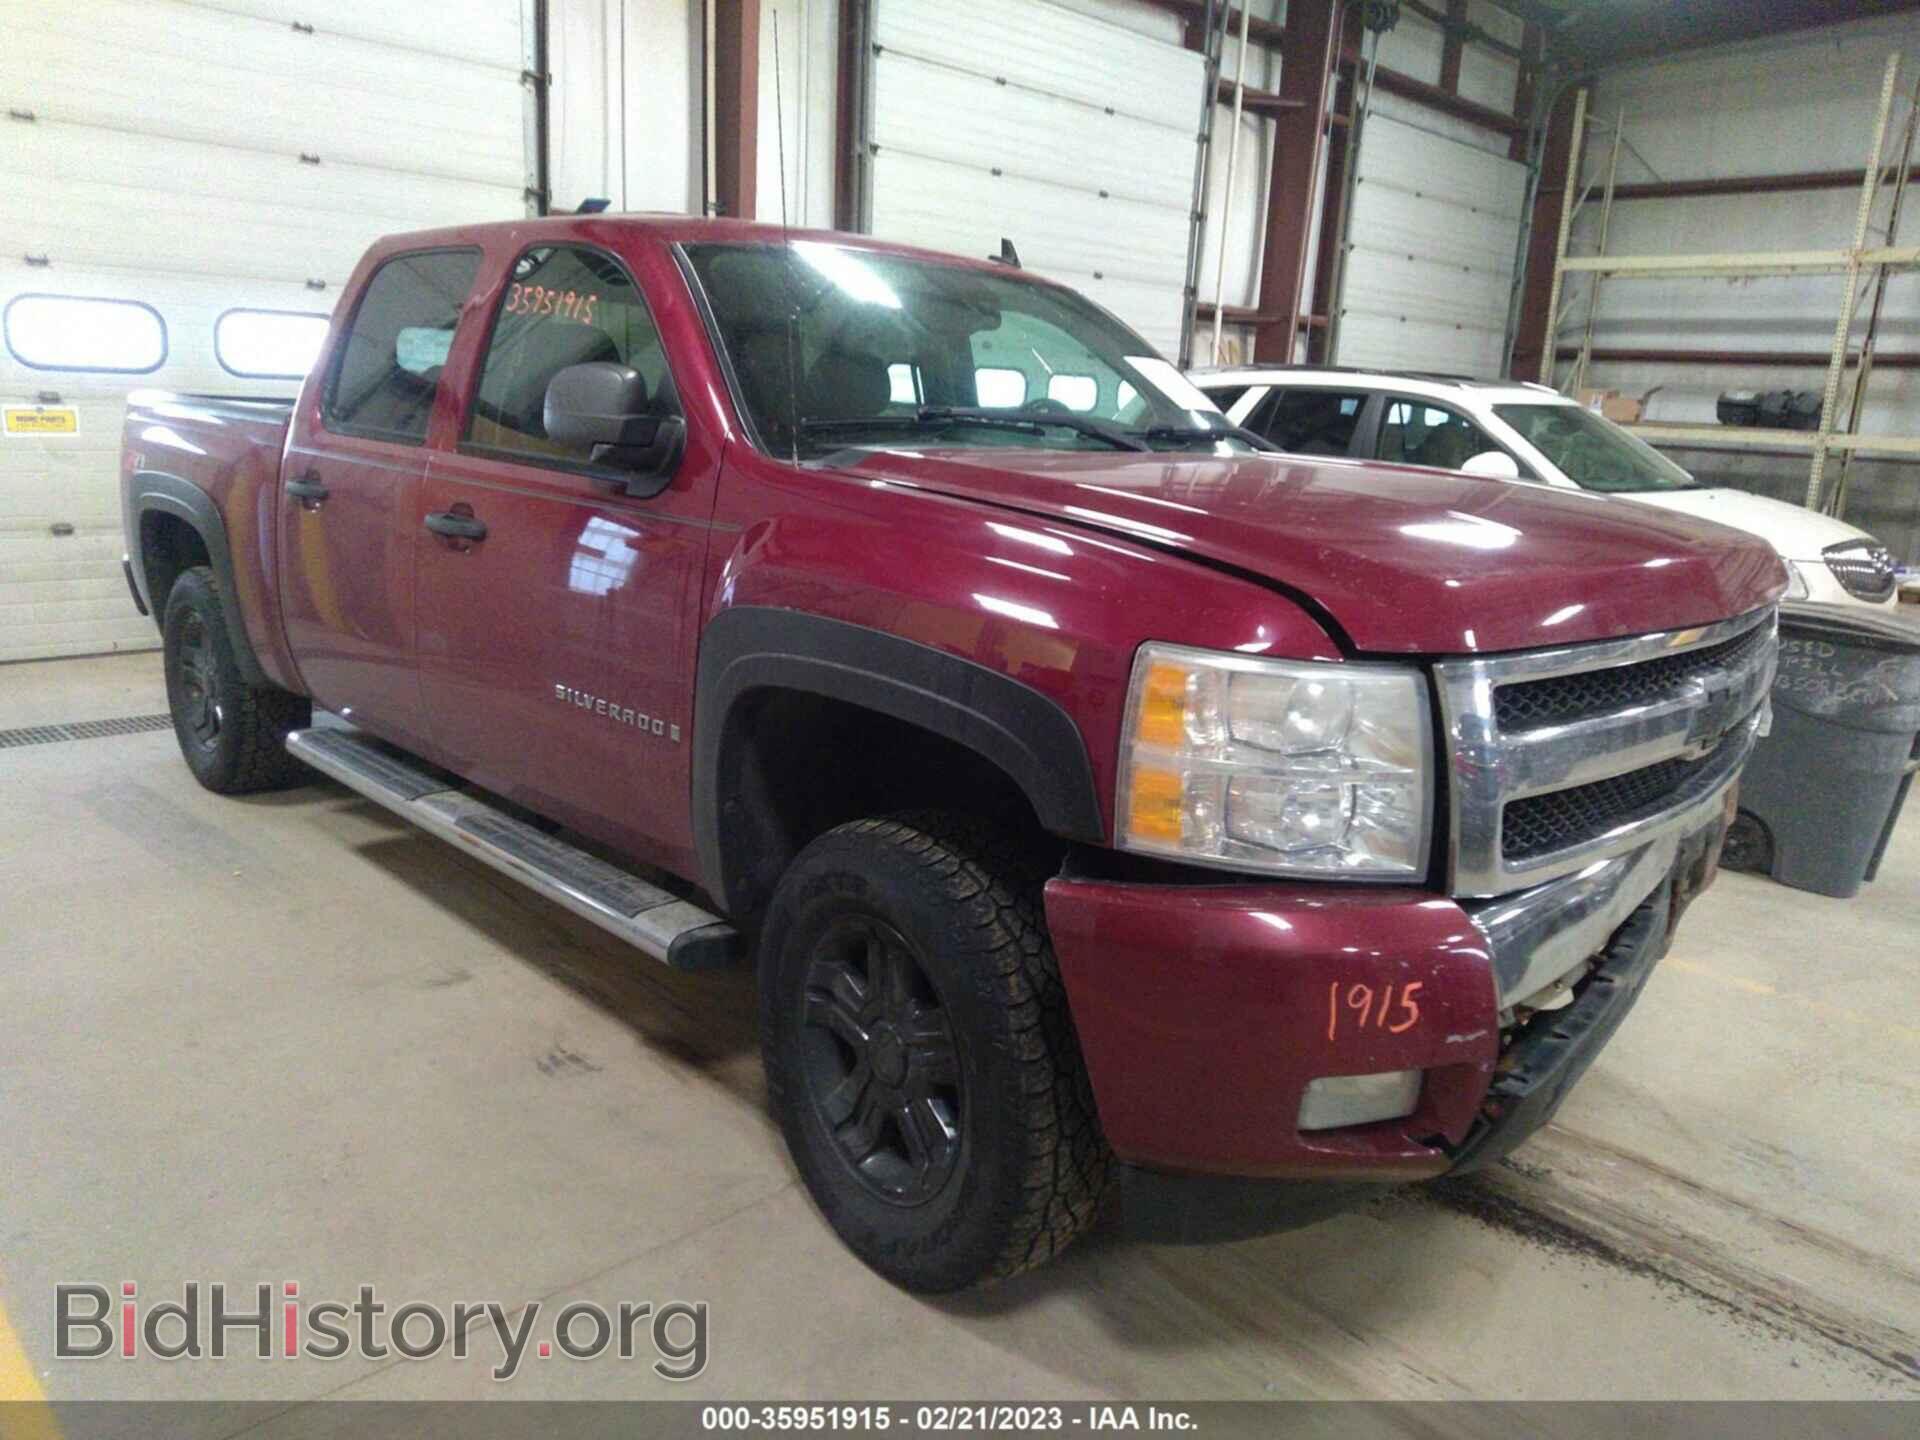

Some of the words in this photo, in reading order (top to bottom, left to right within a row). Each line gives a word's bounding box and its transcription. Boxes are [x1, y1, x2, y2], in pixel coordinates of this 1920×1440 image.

[505, 283, 598, 325] 35951915
[555, 684, 664, 737] SILVERADO
[1328, 981, 1423, 1041] 1915
